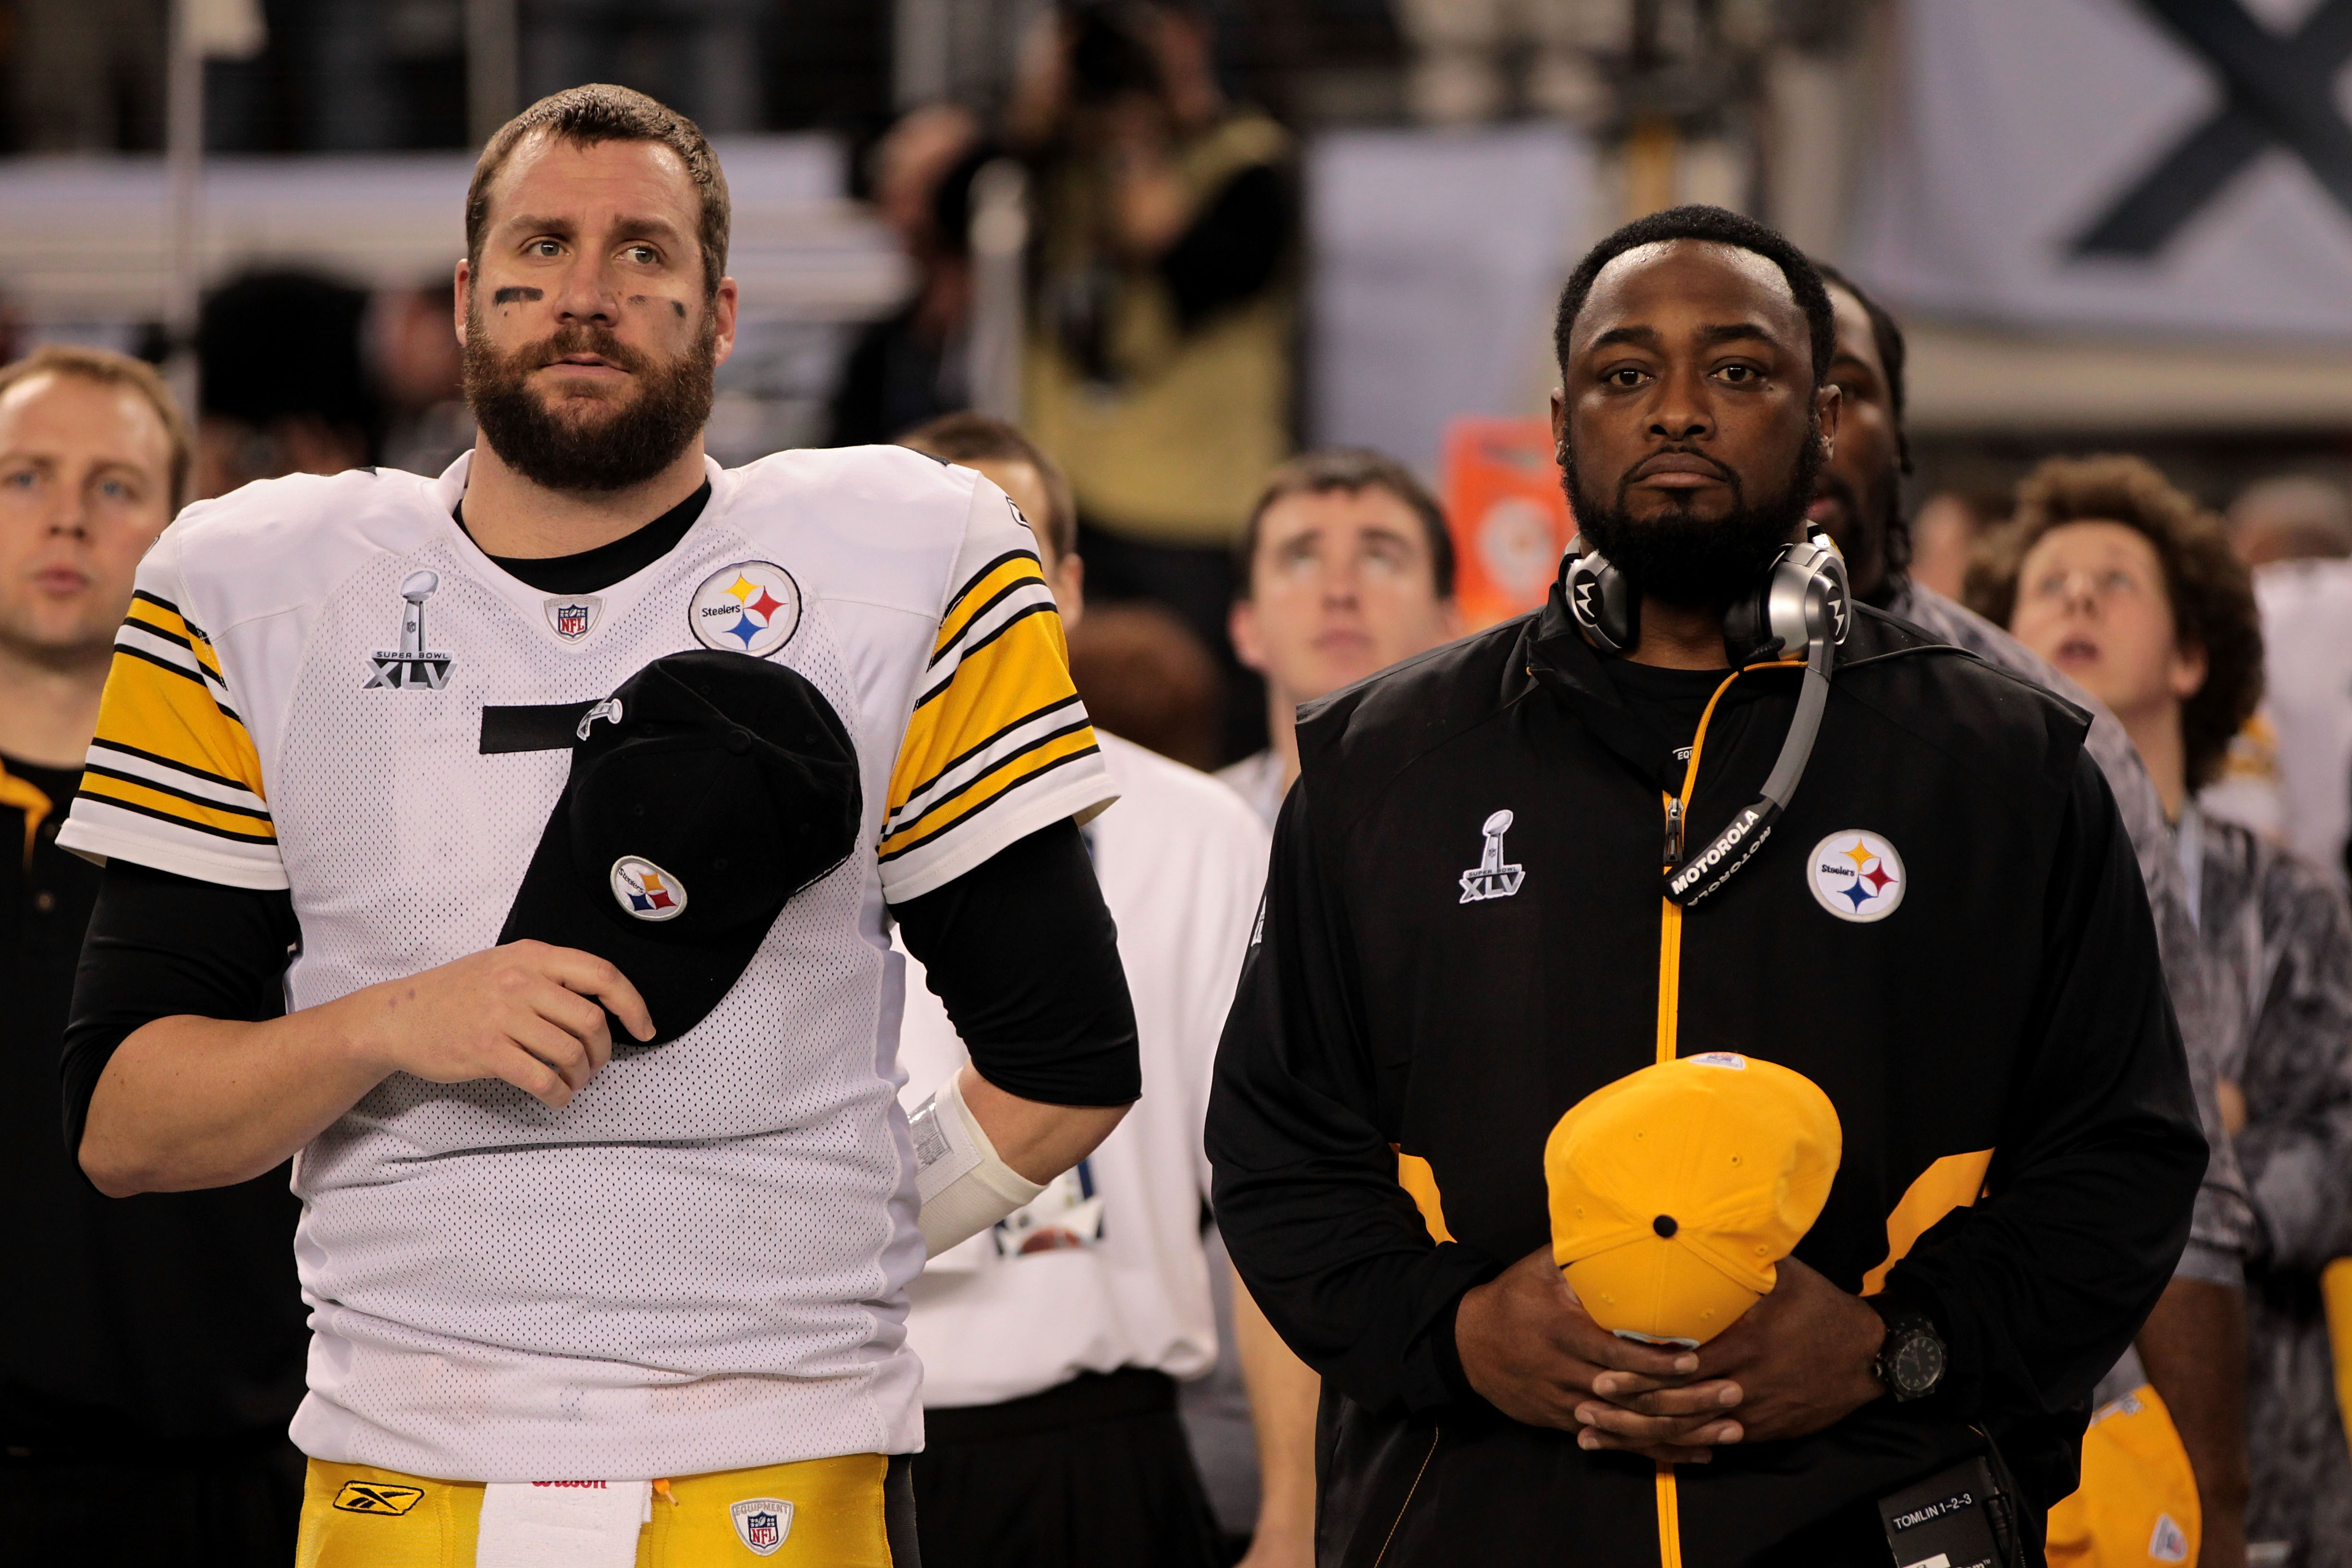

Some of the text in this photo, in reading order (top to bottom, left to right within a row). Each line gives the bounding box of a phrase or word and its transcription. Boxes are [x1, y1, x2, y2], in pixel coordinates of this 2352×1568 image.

[702, 605, 740, 617] Steelers
[561, 618, 585, 634] NFL
[363, 660, 457, 690] XLV
[1671, 810, 1759, 895] MOTOROLA
[1469, 870, 1492, 878] SUPER
[1687, 826, 1771, 906] MOTOROLA
[1822, 865, 1855, 876] Steelers
[619, 868, 644, 894] Steelers
[1461, 871, 1525, 900] XLV
[735, 1502, 788, 1516] EQUIPMENT
[1893, 1493, 1972, 1529] TOMLIN 1-2-3
[751, 1528, 775, 1544] NFL
